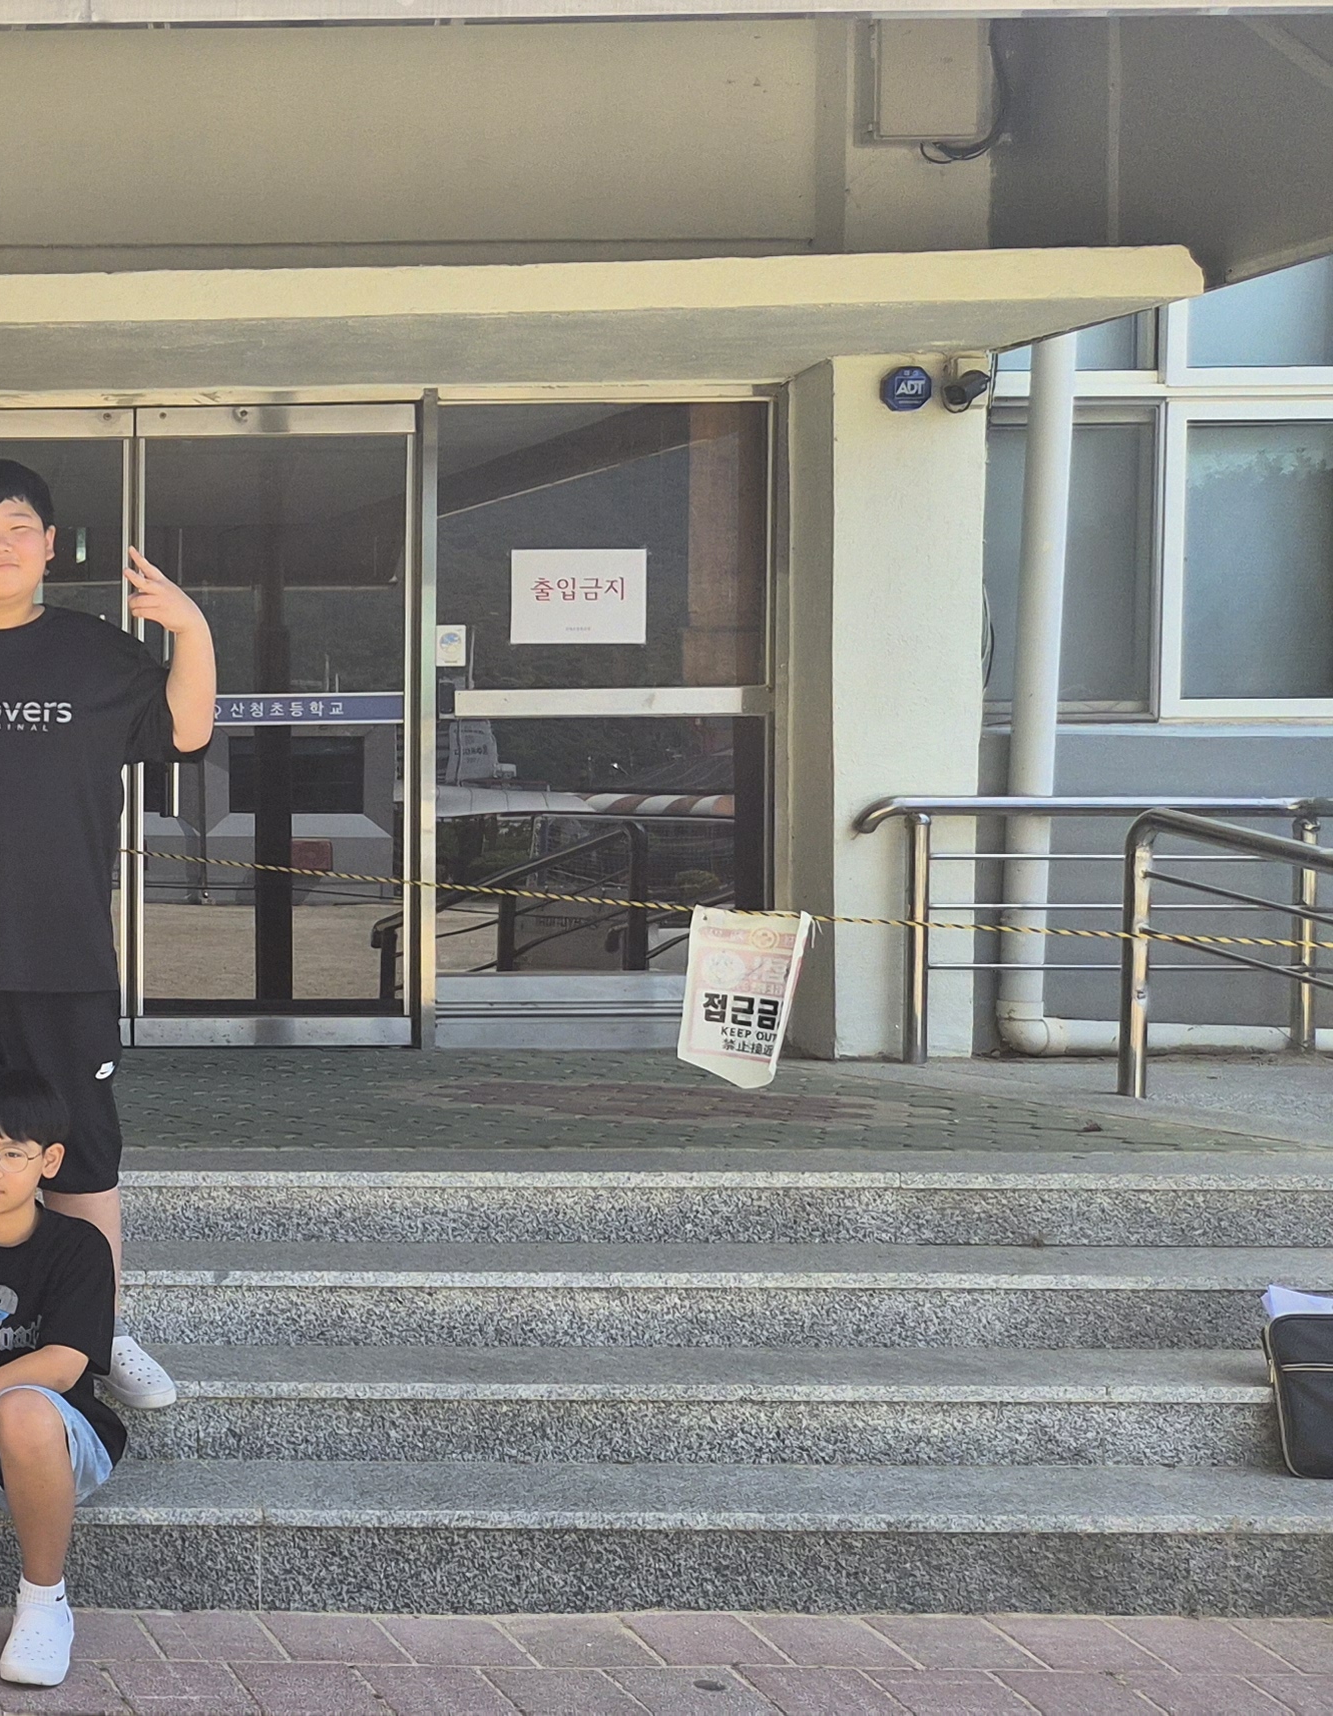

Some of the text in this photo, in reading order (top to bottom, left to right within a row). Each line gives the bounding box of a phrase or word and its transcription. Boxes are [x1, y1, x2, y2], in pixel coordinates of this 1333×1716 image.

[895, 380, 926, 395] ADT
[530, 576, 625, 602] 출입금지
[230, 701, 344, 718] 산청초등학교
[720, 1026, 779, 1043] KEEP OUT
